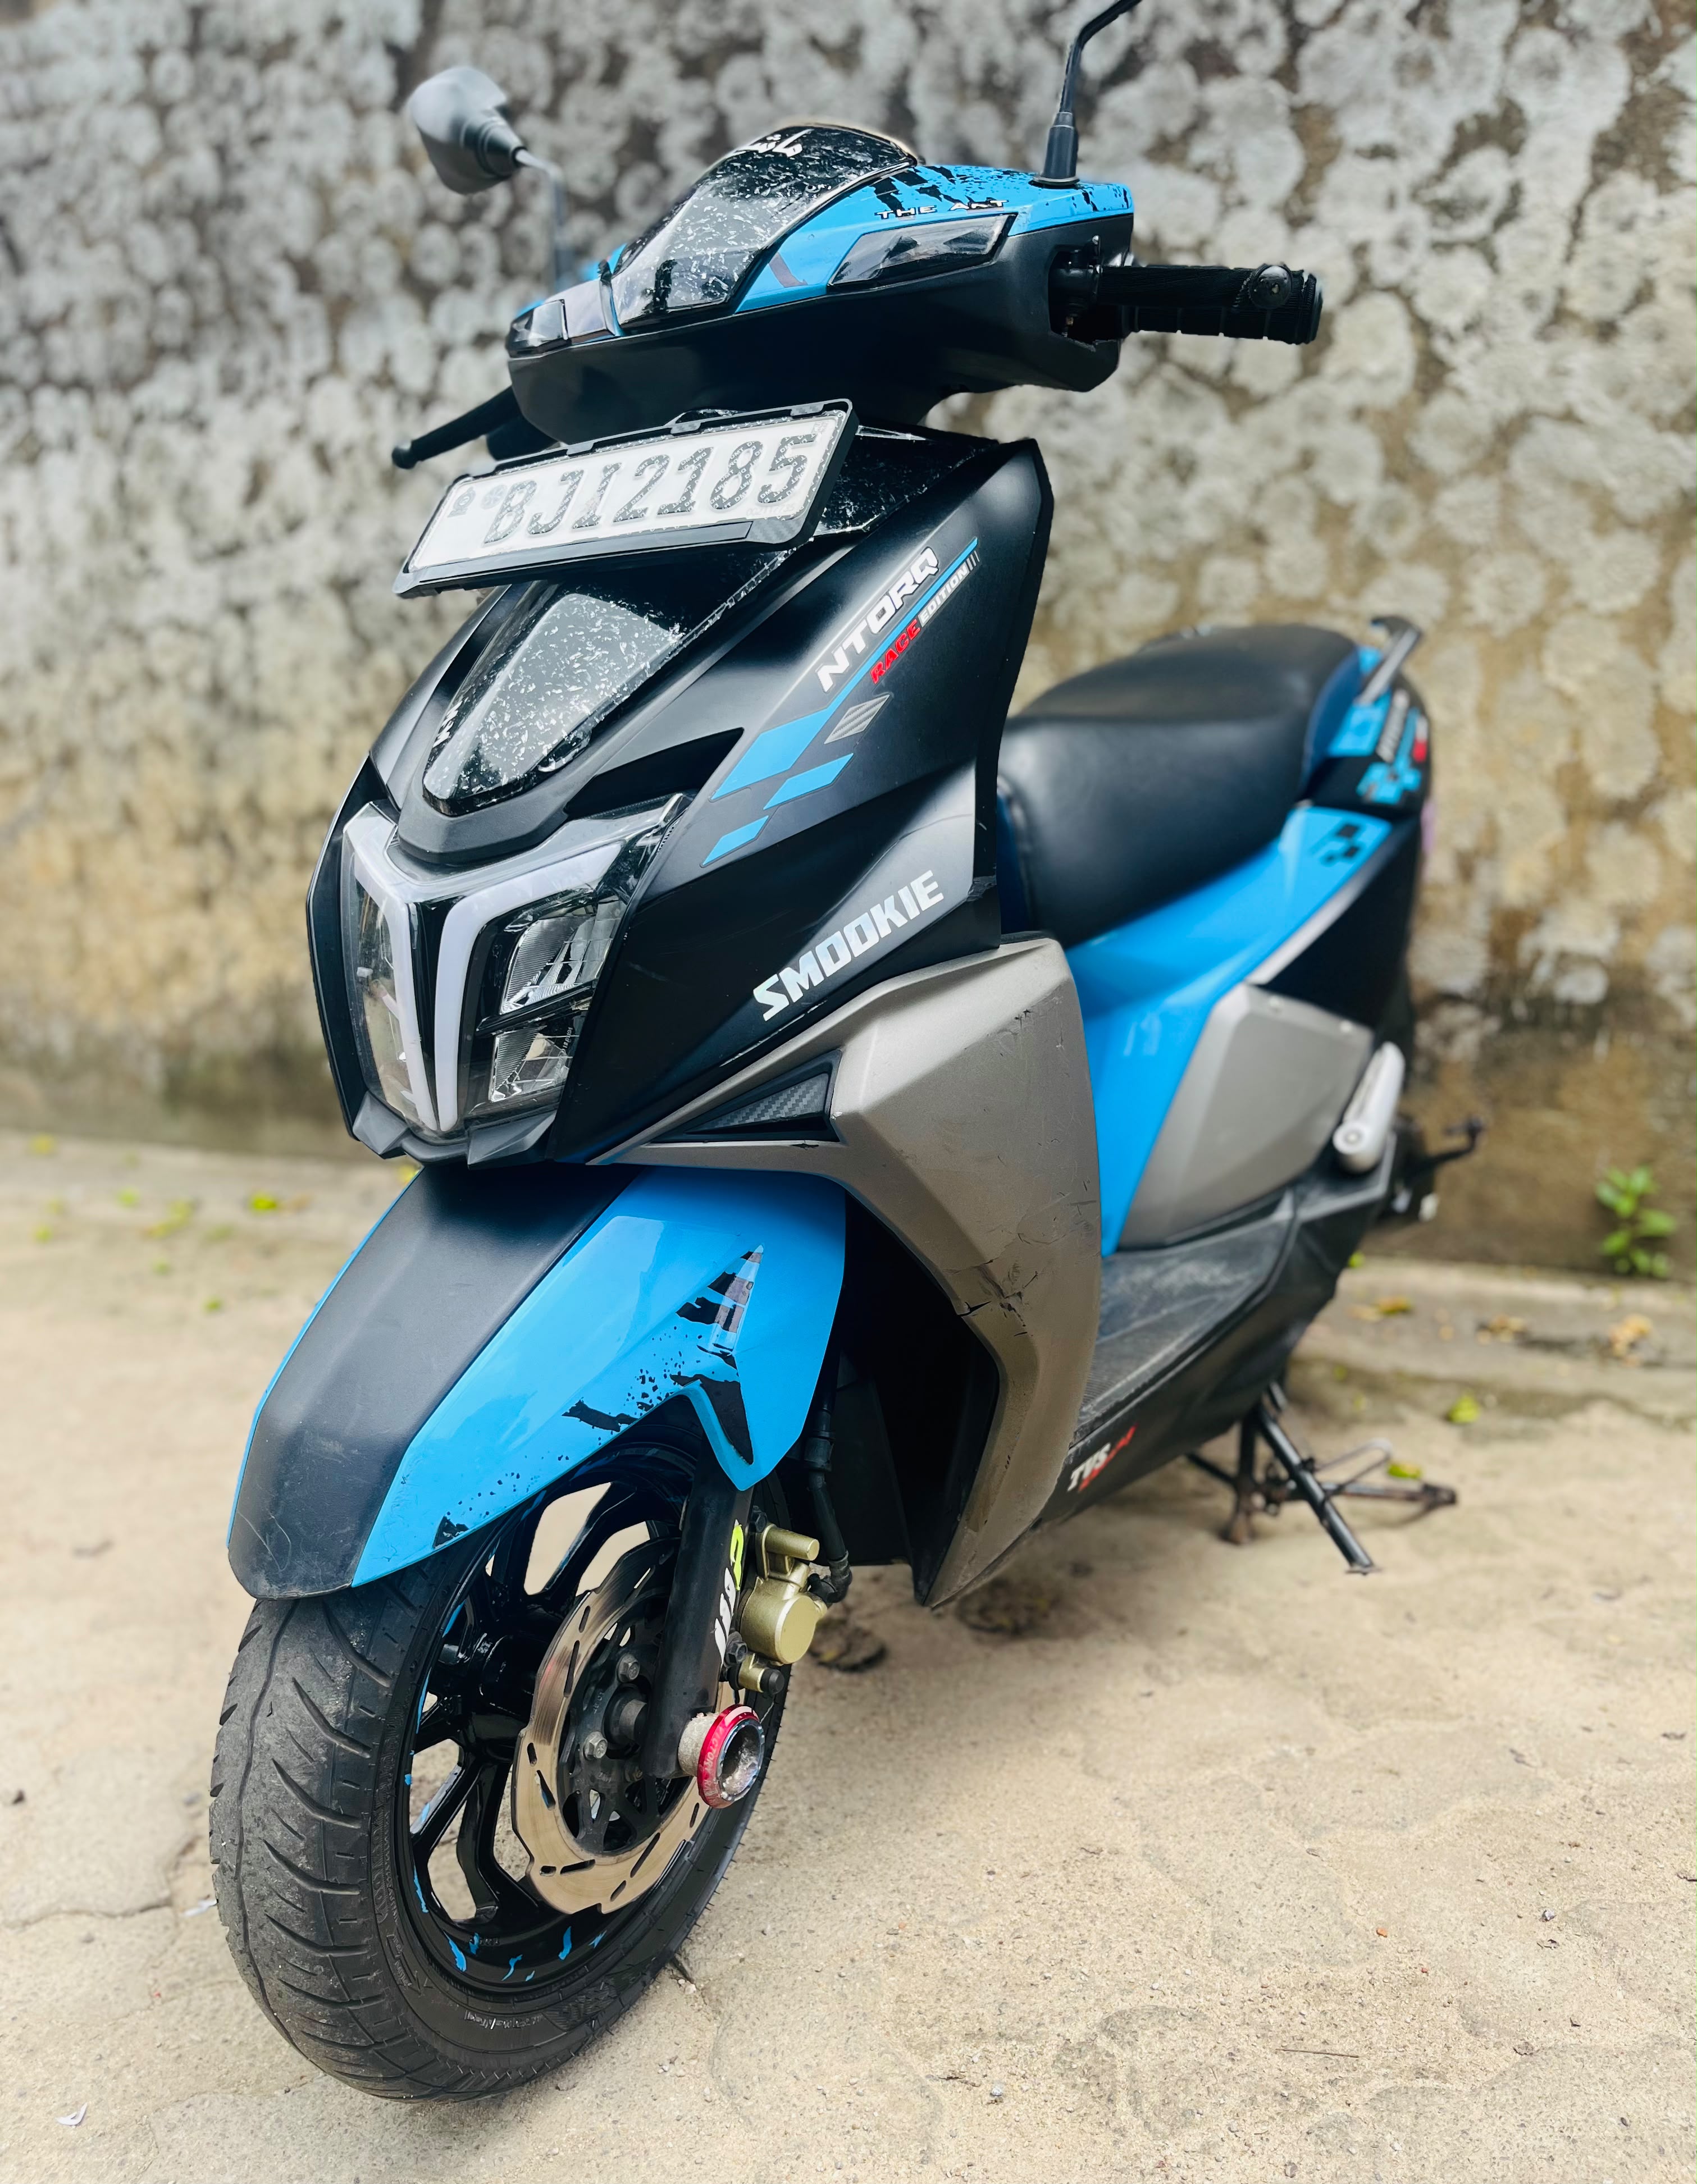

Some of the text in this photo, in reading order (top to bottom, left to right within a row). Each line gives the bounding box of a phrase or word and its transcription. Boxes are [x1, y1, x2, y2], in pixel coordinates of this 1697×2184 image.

[875, 204, 937, 220] THE
[816, 546, 939, 692] NTORQ
[871, 564, 969, 684] RACE EDITION
[753, 870, 944, 1021] SMOOKIE
